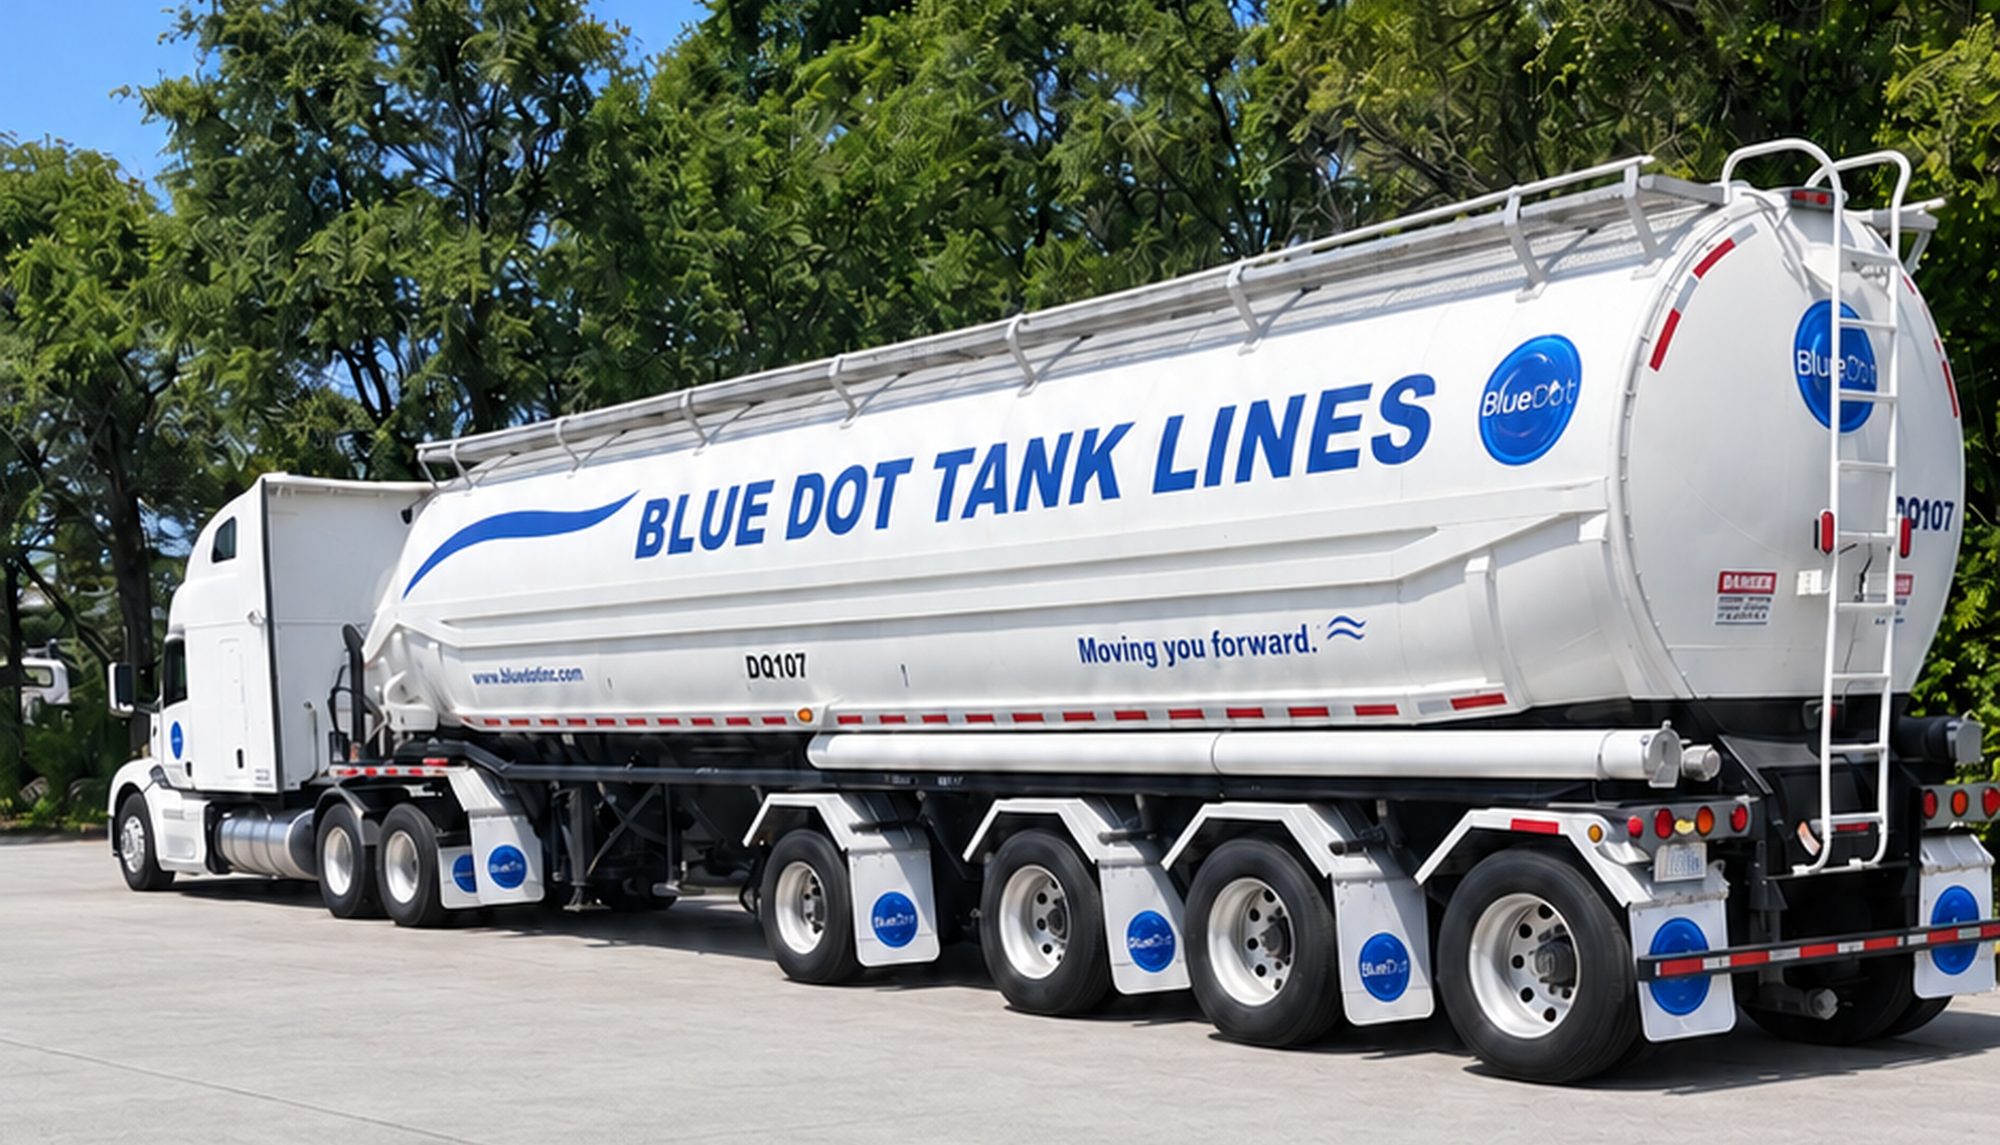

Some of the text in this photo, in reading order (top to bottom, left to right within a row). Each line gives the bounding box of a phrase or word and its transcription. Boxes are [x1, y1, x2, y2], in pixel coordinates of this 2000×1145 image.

[635, 373, 1436, 560] BLUE DOT TANK LINES
[745, 652, 806, 680] DQ107
[1077, 623, 1318, 669] Moving you forward.
